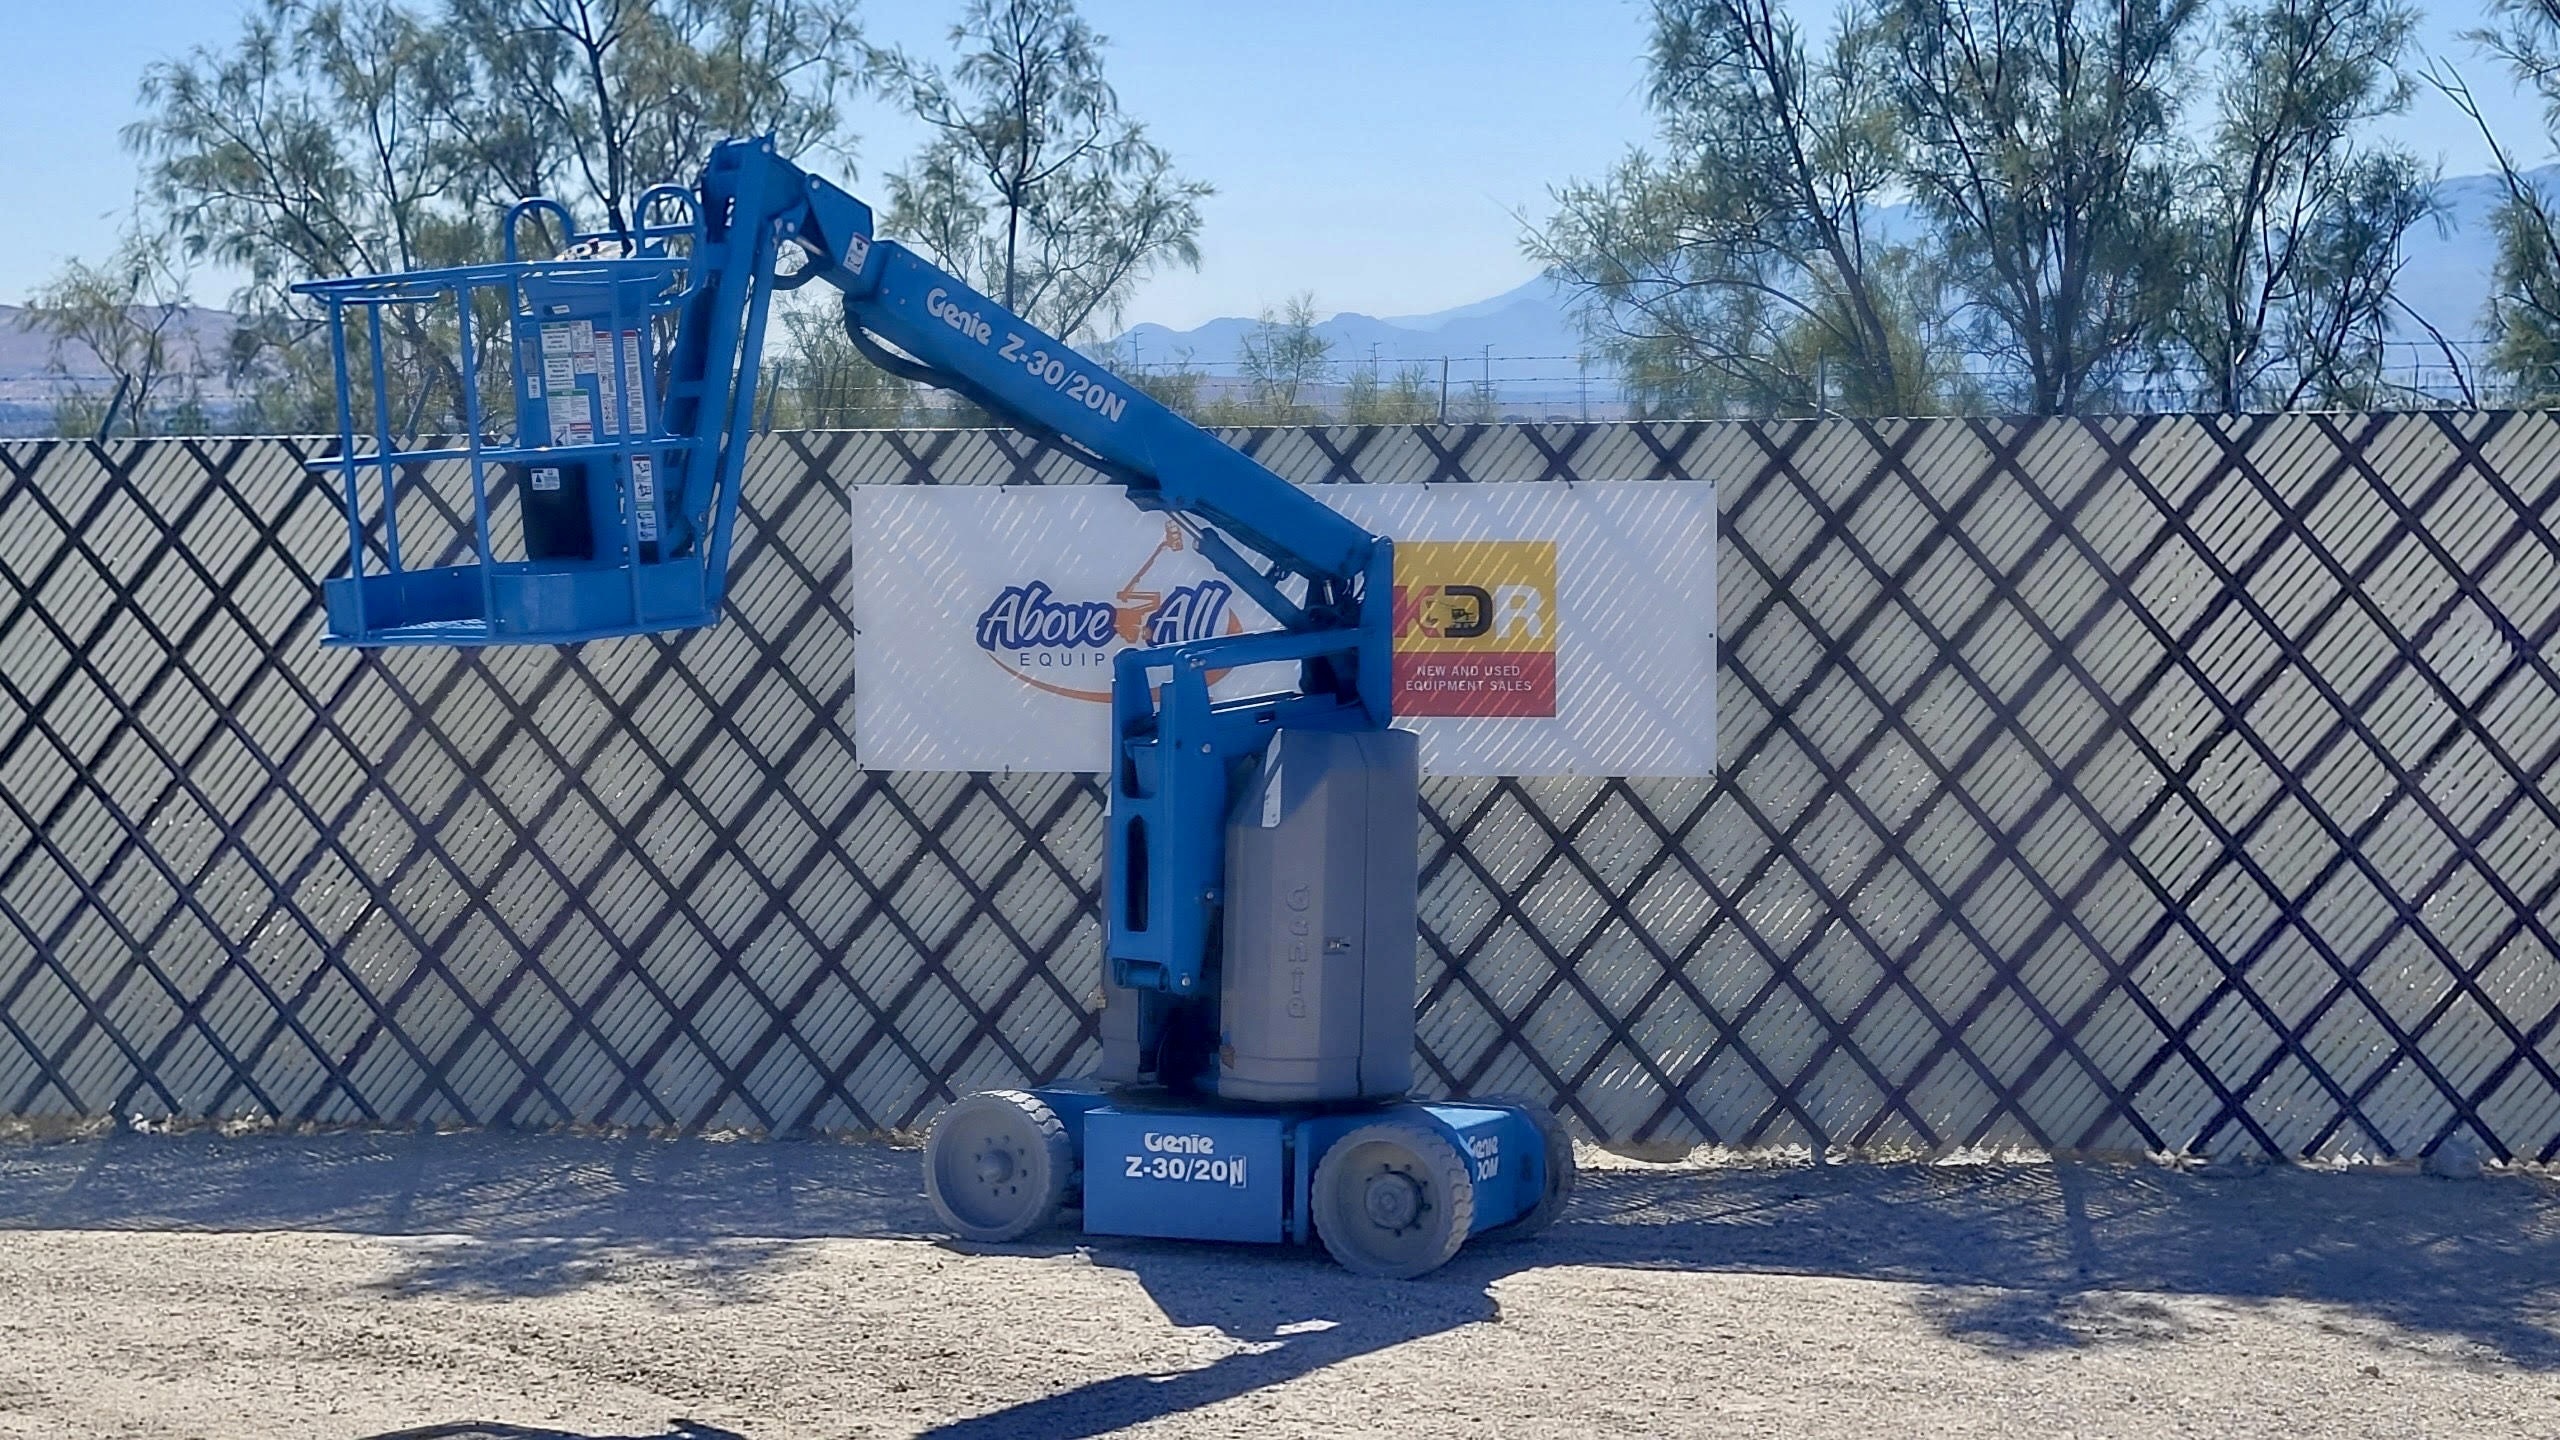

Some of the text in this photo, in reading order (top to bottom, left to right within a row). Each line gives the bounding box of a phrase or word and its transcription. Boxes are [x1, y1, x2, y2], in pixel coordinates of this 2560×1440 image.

[926, 287, 1128, 423] Genie Z-30/20N
[976, 580, 1232, 651] Above All
[1393, 585, 1543, 638] KDR
[1019, 652, 1106, 666] EQUIP
[1416, 665, 1520, 677] NEW AND USED
[1405, 680, 1532, 691] EQUIPMENT SALES
[1144, 1132, 1214, 1154] Genie
[1125, 1156, 1246, 1188] Z-30/20N
